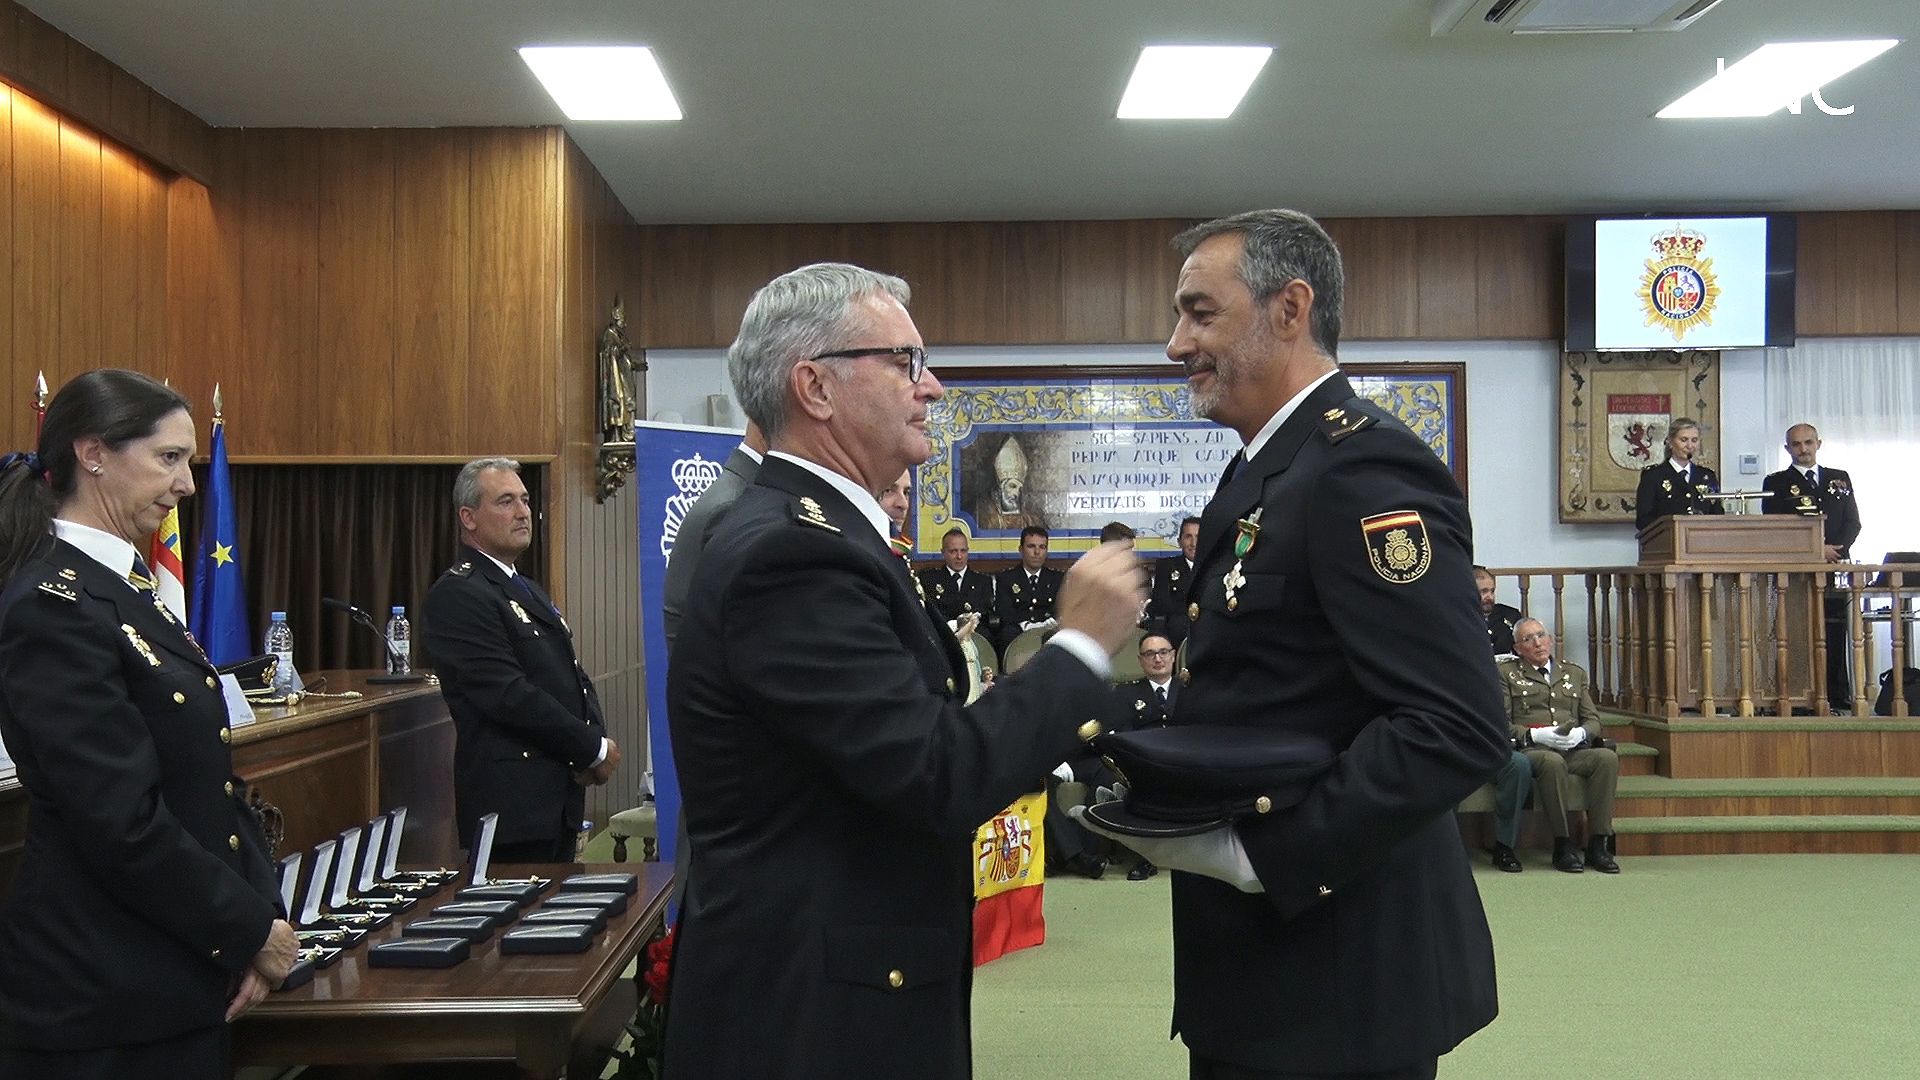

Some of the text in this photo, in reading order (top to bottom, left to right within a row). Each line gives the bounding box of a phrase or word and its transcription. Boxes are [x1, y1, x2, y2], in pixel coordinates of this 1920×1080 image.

[1092, 431, 1114, 445] SIC
[1205, 431, 1224, 444] AD
[1133, 449, 1180, 466] ATQUE
[1068, 495, 1146, 509] VERITATIS
[1402, 537, 1429, 580] NACIONAL
